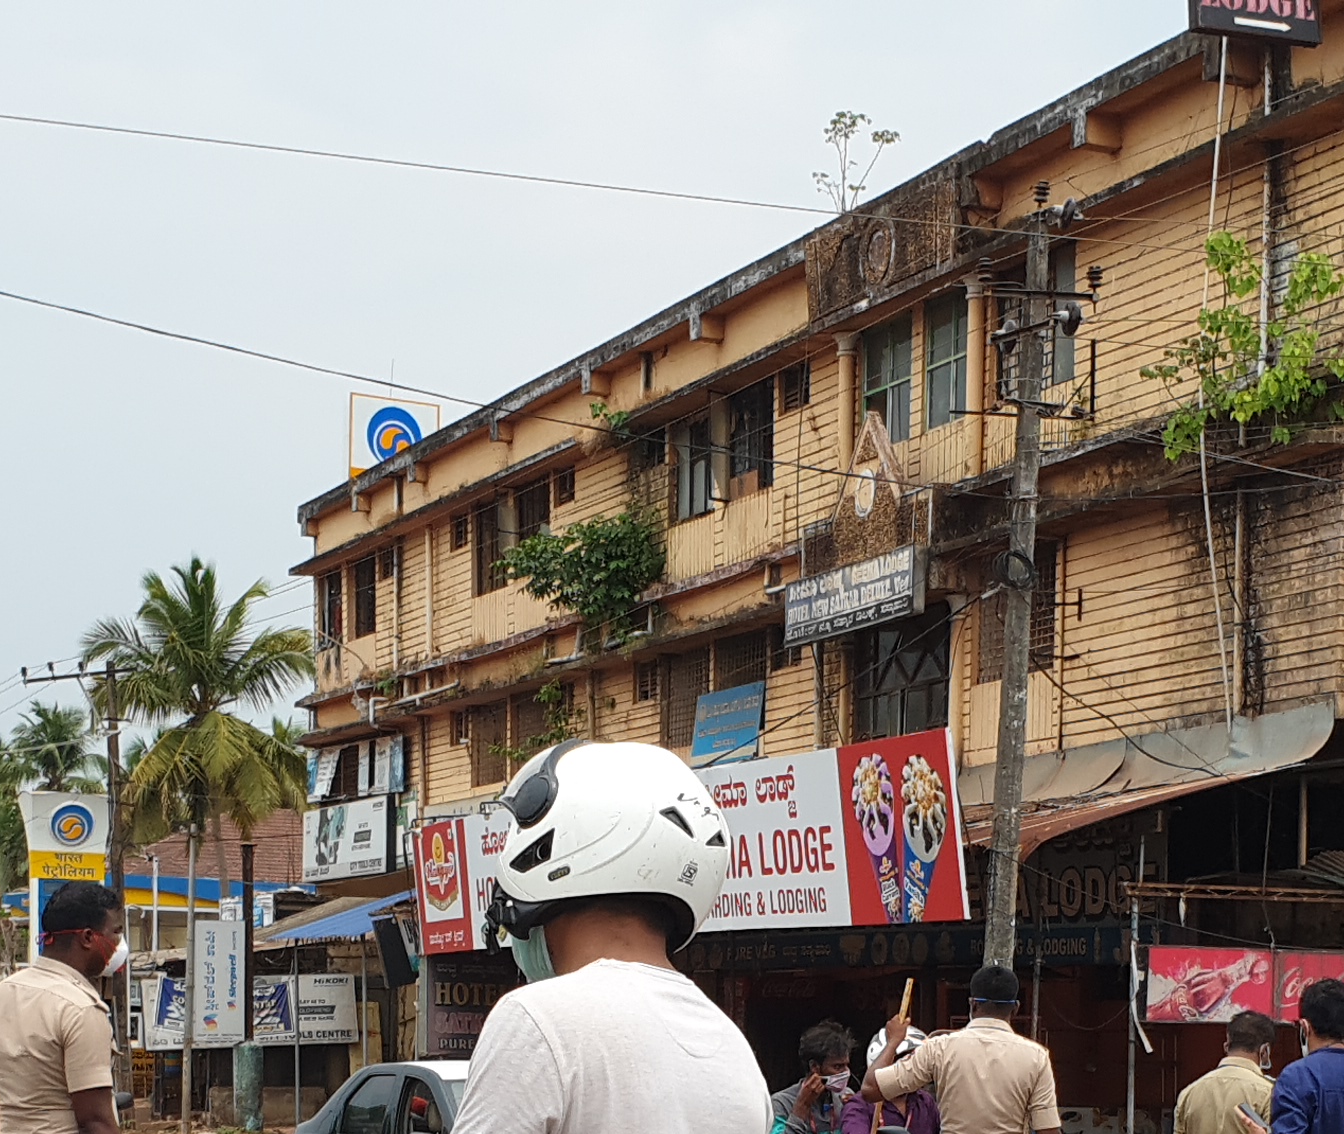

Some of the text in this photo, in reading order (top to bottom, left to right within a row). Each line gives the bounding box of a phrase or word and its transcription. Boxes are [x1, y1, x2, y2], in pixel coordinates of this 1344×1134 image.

[758, 825, 836, 876] LODGE
[708, 887, 827, 919] RDING & LODGING
[1040, 938, 1087, 955] ODGING
[227, 953, 238, 998] Sleepwell
[316, 1029, 353, 1039] CENTRE
[435, 1011, 485, 1034] SATK
[439, 1038, 475, 1050] PURE
